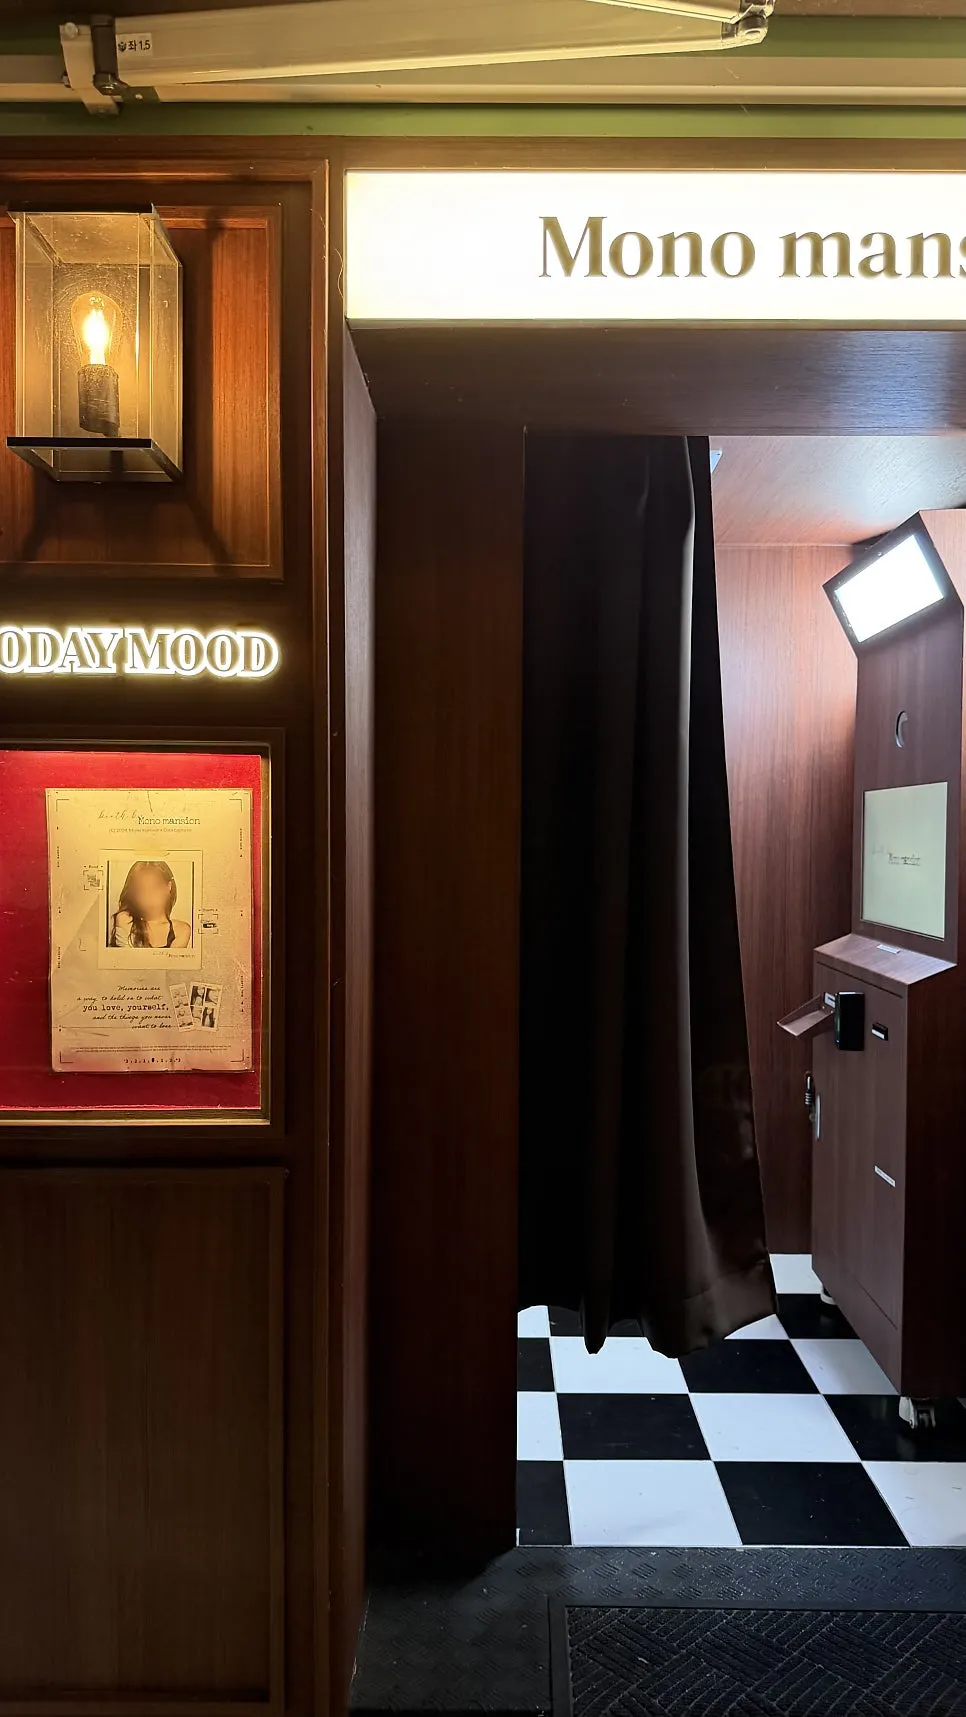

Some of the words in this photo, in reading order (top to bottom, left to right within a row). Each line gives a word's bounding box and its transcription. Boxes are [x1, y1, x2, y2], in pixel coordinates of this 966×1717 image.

[538, 215, 756, 279] Mono
[778, 230, 966, 280] man
[138, 816, 161, 825] Mono
[162, 816, 201, 825] mansion
[82, 1004, 98, 1012] you
[101, 1003, 124, 1011] love,
[127, 1003, 169, 1012] yourself,
